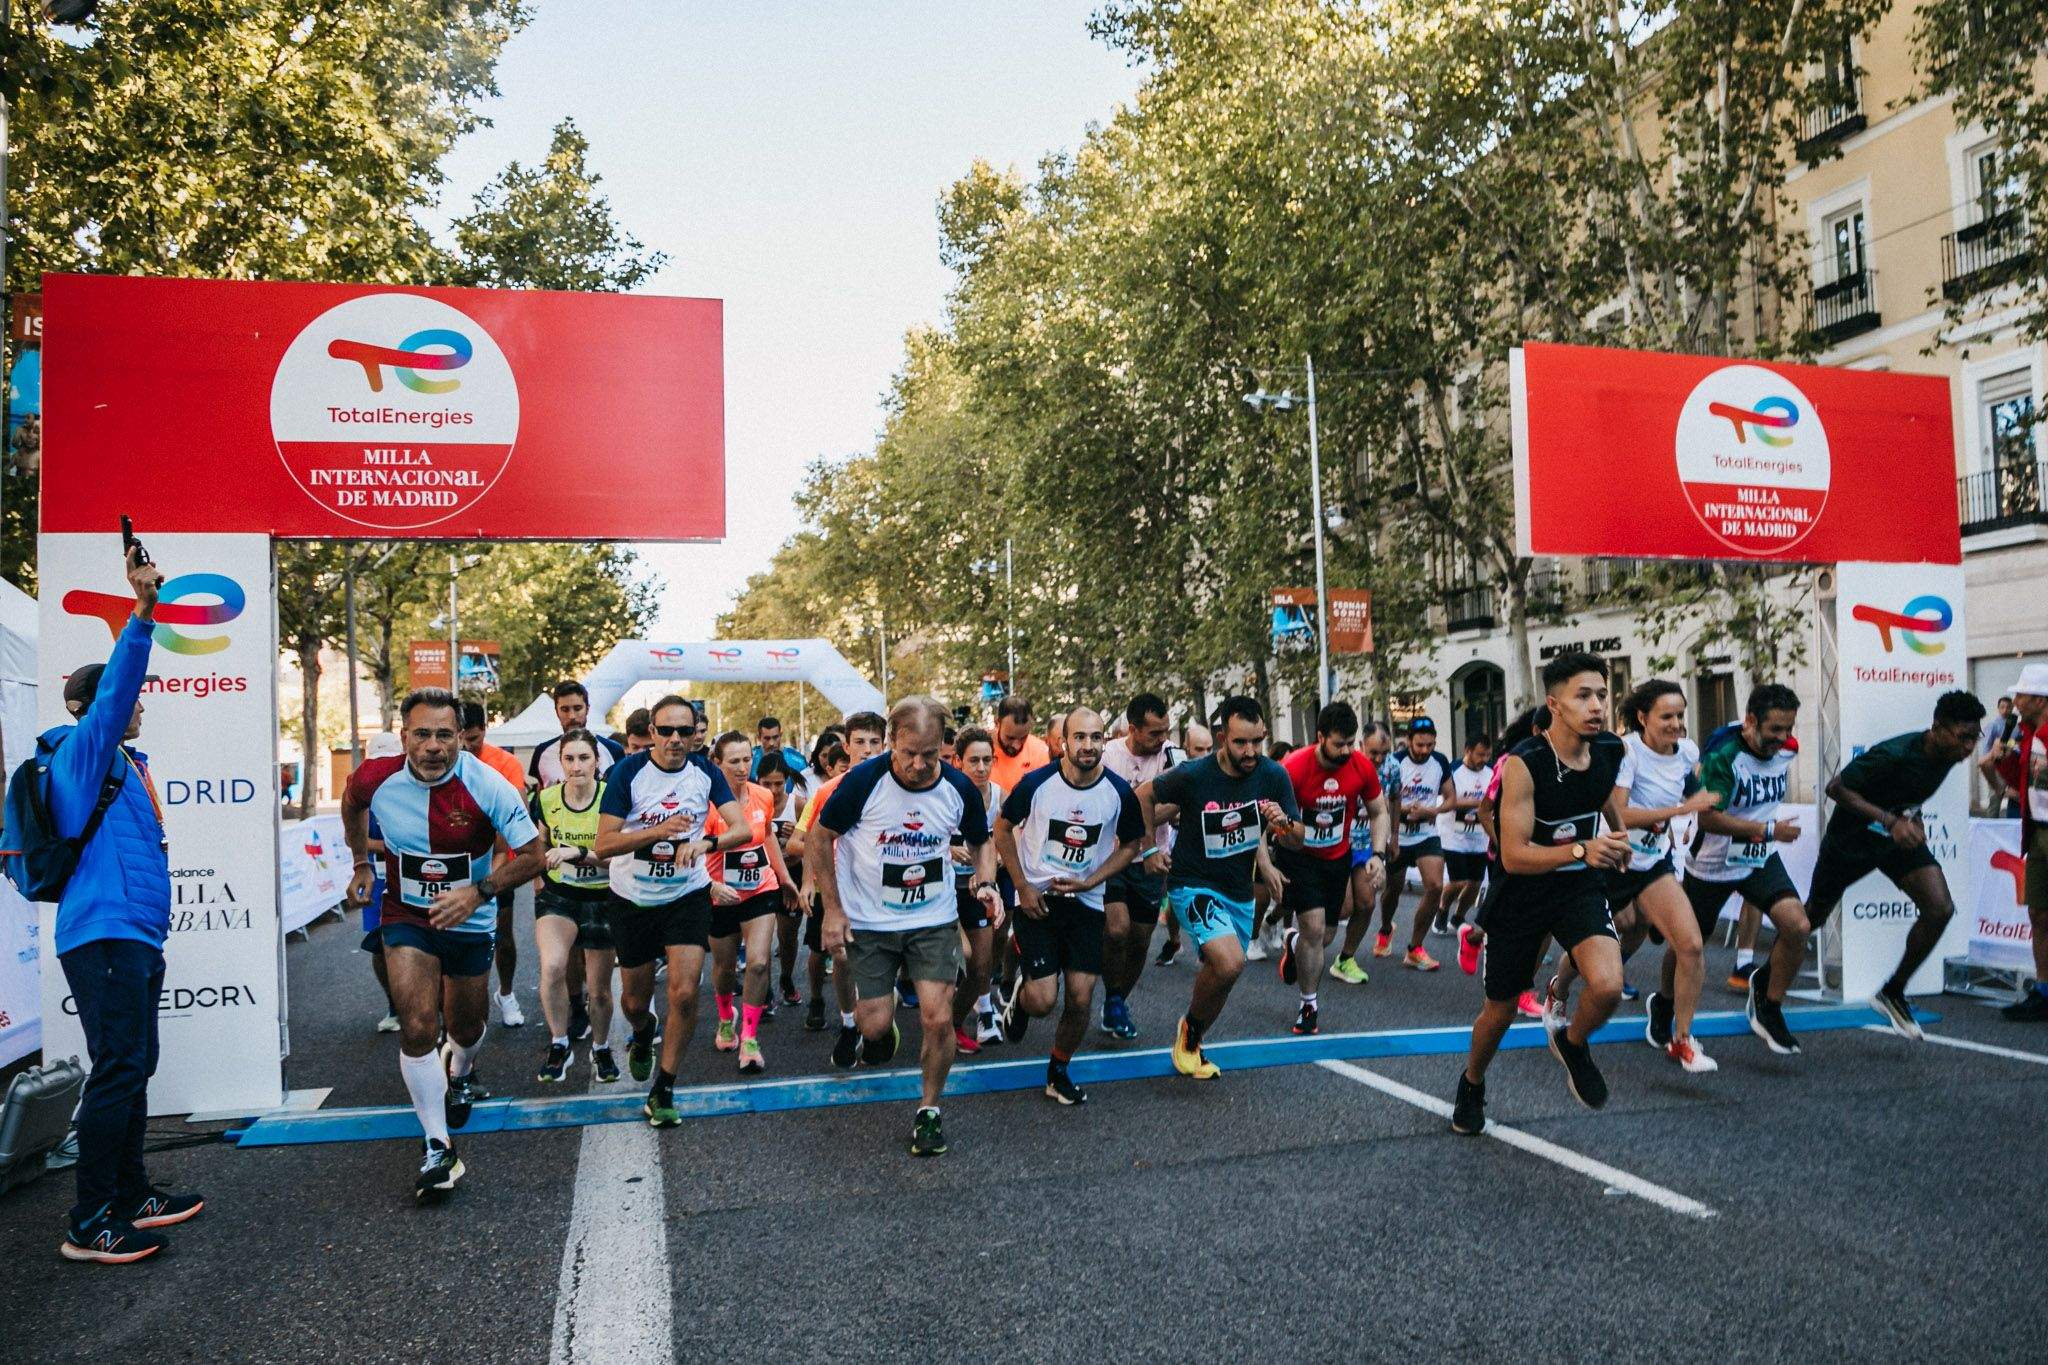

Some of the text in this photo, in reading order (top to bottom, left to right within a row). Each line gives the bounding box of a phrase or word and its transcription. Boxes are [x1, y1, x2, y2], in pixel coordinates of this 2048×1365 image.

[24, 316, 42, 337] IS
[327, 407, 473, 429] TotalEnergies
[363, 449, 432, 466] MILLA
[1713, 454, 1803, 475] TotalEnergies
[337, 490, 459, 508] DE MADRID
[1737, 488, 1780, 505] MILLA
[1721, 520, 1797, 538] DE MADRID
[1590, 636, 1622, 652] KORS
[1854, 666, 1955, 688] TotalEnergies
[166, 779, 255, 805] DRID
[1221, 829, 1246, 848] 783
[1062, 844, 1086, 863] 778
[1743, 841, 1767, 859] 468
[170, 867, 215, 878] alance
[575, 866, 598, 878] 773
[648, 862, 675, 878] 755
[738, 868, 760, 882] 786
[176, 882, 237, 905] LLA
[418, 882, 452, 898] 795
[900, 885, 926, 904] 774
[1853, 902, 1920, 920] CORRE
[1977, 918, 2032, 940] TotalE
